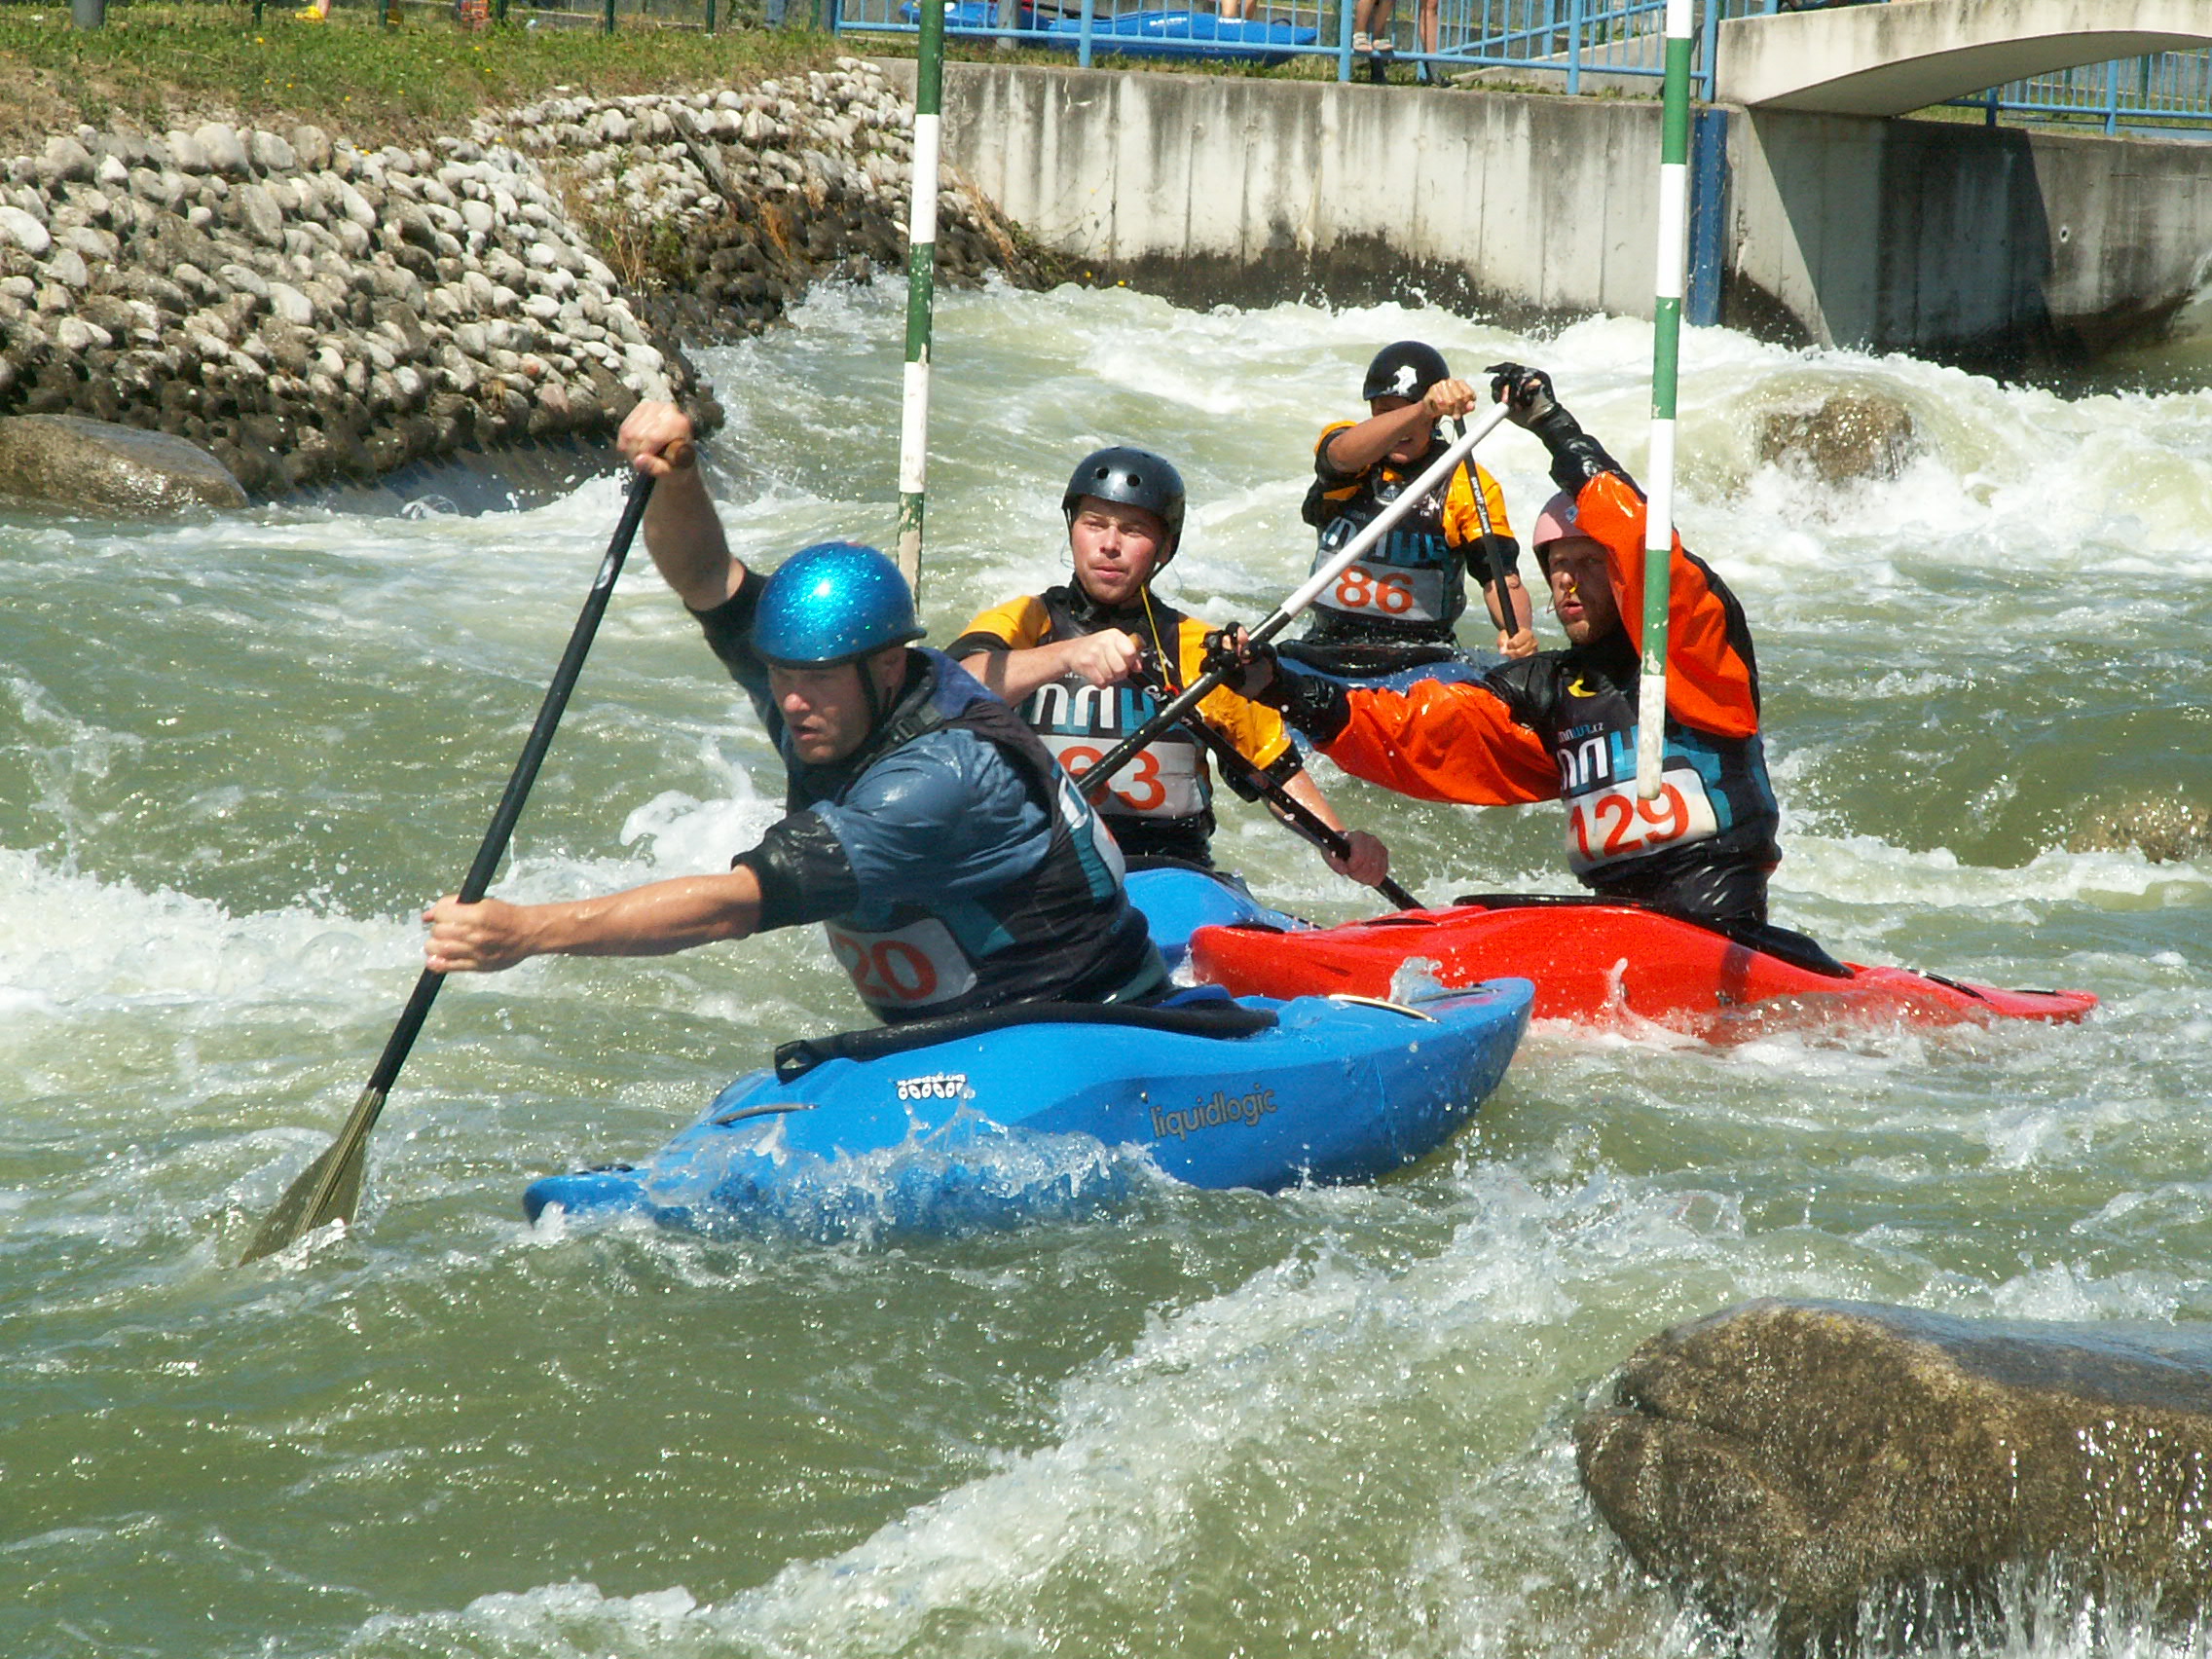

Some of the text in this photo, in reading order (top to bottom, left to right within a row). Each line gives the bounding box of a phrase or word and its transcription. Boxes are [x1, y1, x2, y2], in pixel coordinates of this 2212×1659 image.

[1335, 565, 1415, 615] 86
[1569, 782, 1689, 862] 129
[1150, 1083, 1278, 1142] liquidlogic
